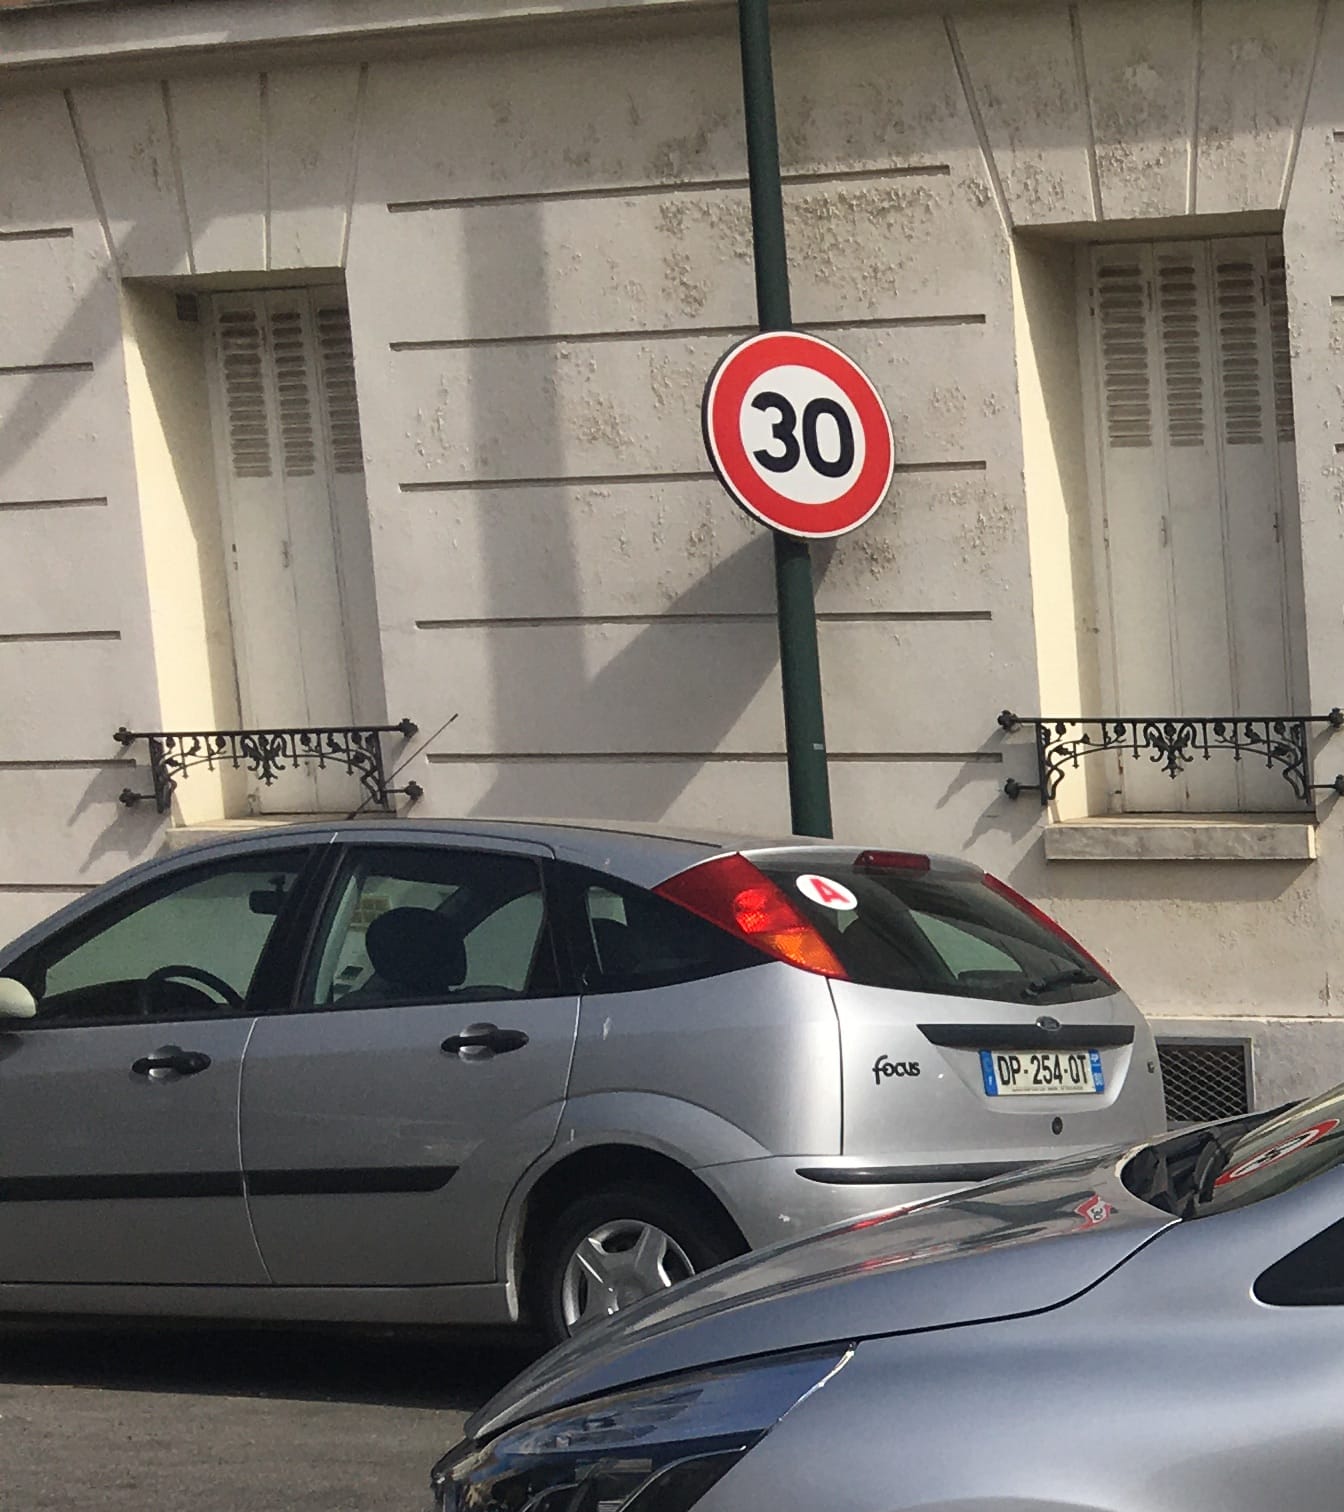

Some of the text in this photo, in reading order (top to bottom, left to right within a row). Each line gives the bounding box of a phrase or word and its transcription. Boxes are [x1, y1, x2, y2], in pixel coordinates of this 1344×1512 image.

[751, 391, 855, 478] 30
[810, 878, 850, 903] A
[872, 1055, 921, 1085] focus
